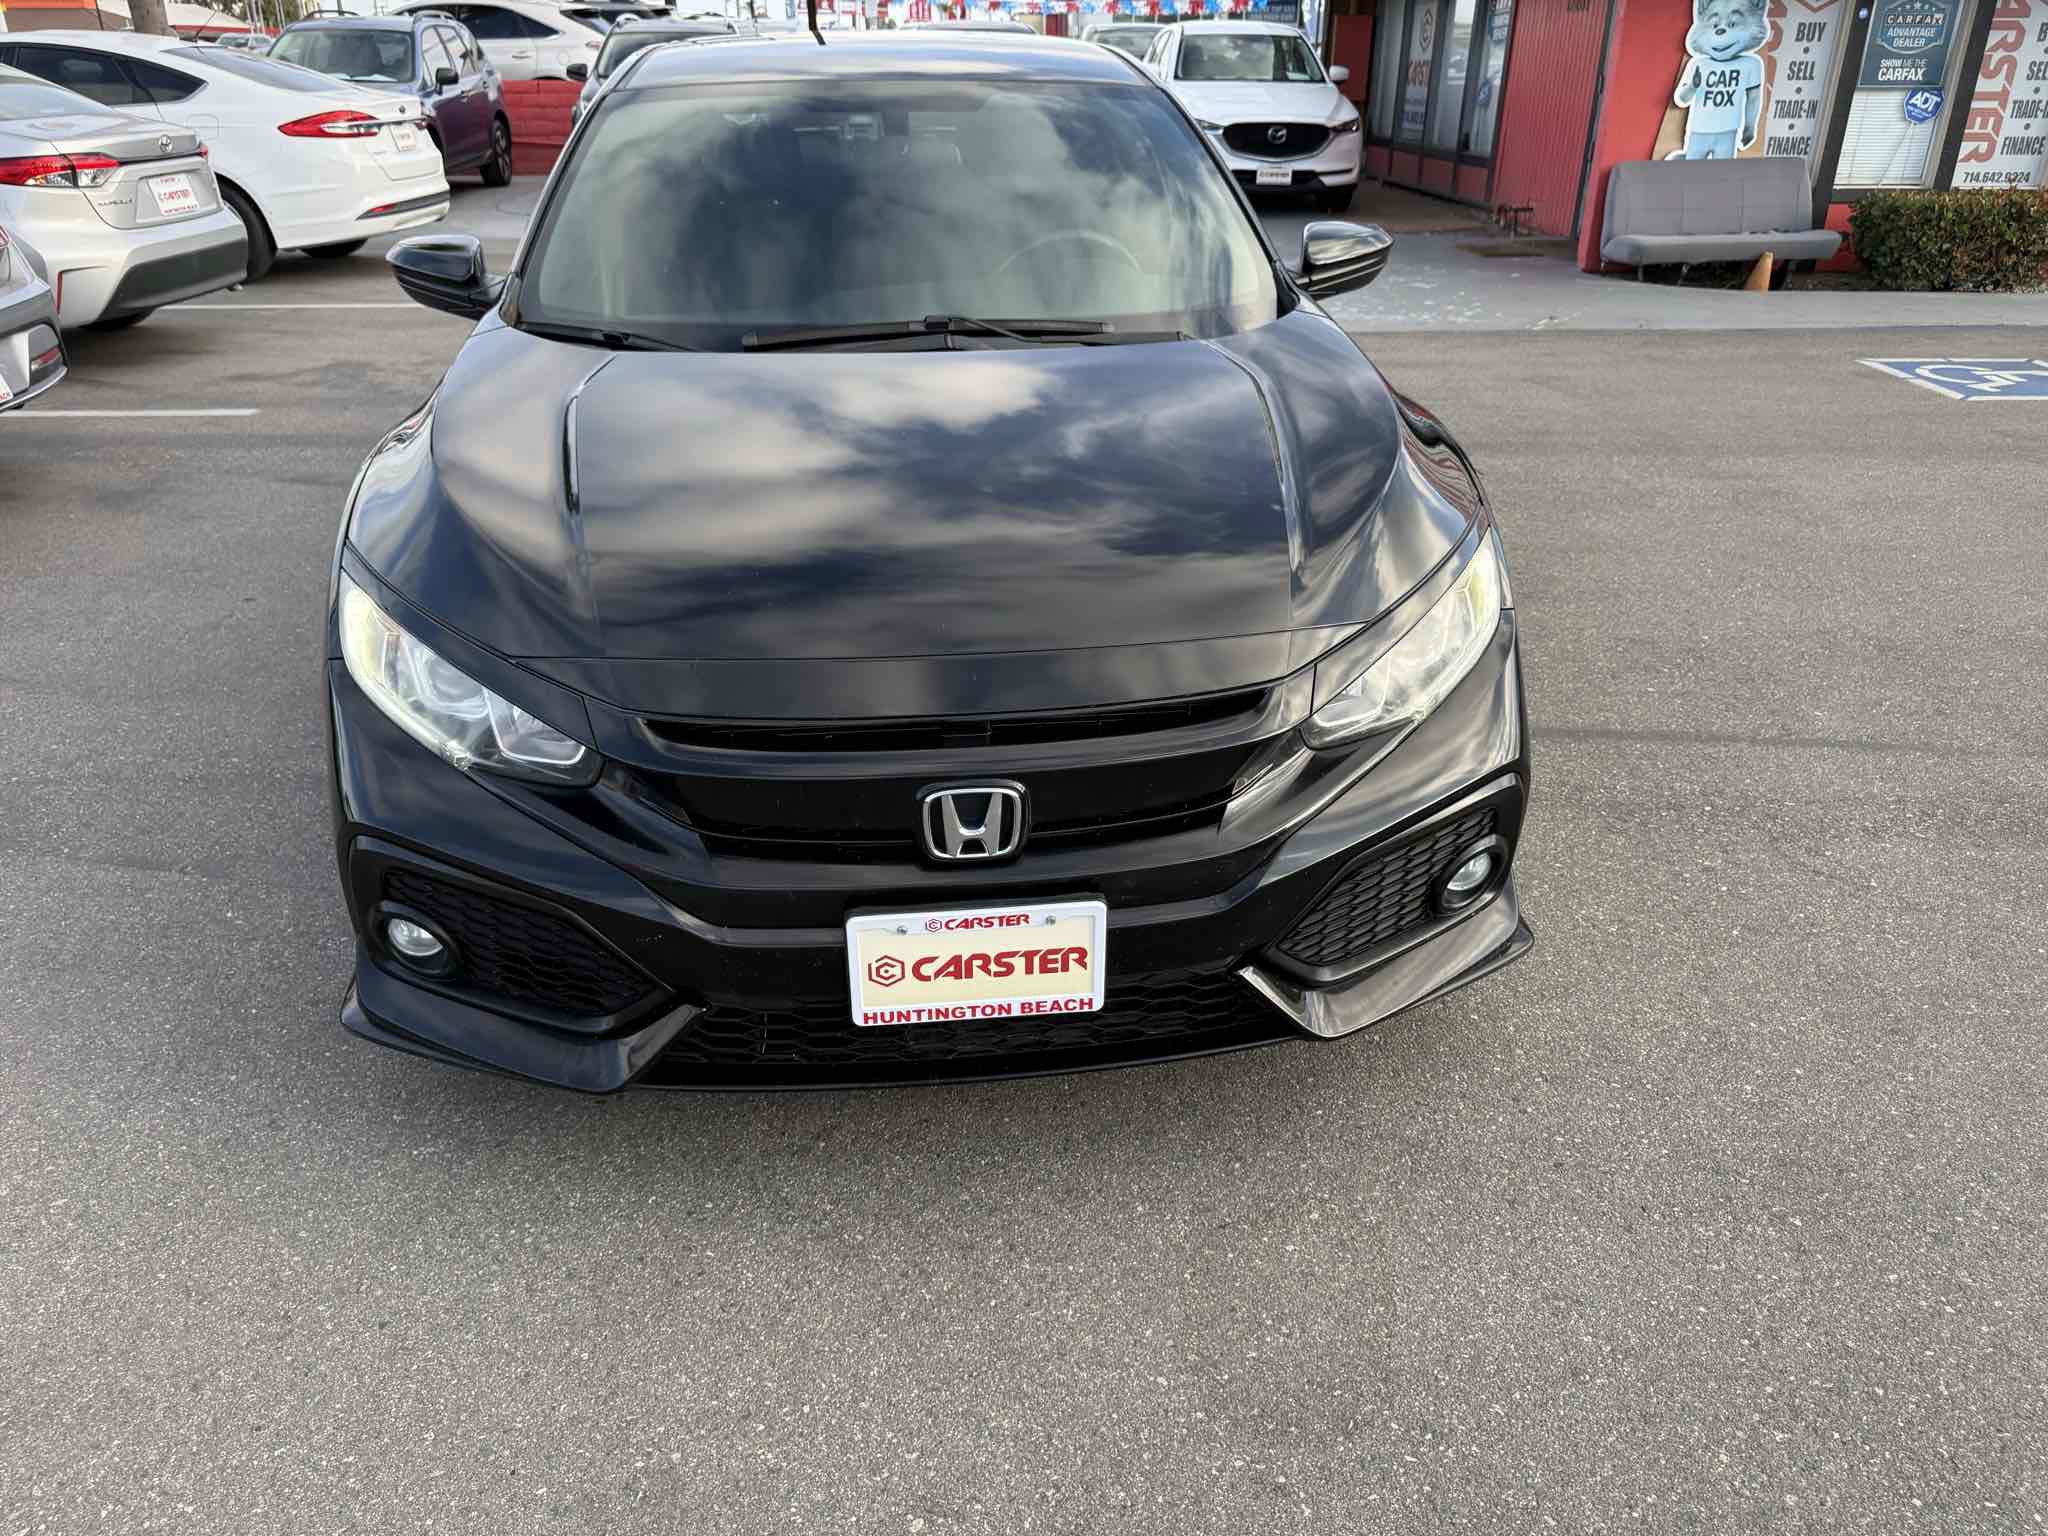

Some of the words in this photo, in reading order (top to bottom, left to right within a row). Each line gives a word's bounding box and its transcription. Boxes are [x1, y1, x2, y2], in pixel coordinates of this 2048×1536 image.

[1794, 22, 1826, 42] BUY
[1887, 26, 1936, 37] ADVANTAGE
[1892, 38, 1926, 47] DEALER
[1787, 61, 1815, 81] SELL
[1880, 58, 1901, 68] SHOW
[2026, 61, 2048, 81] SEL
[1705, 70, 1740, 88] CAR
[1878, 67, 1927, 81] CARFAX
[1703, 89, 1736, 108] FOX
[1909, 91, 1941, 112] ADT
[1773, 99, 1818, 119] TRADE-IN
[2010, 100, 2048, 119] TRADE-I
[1766, 136, 1811, 156] FINANCE
[2000, 136, 2046, 156] FINANCE
[944, 914, 1030, 930] CARSTER
[911, 946, 1088, 982] CARSTER
[863, 1003, 1012, 1025] HUNTINGTON
[1020, 998, 1094, 1014] BEACH
